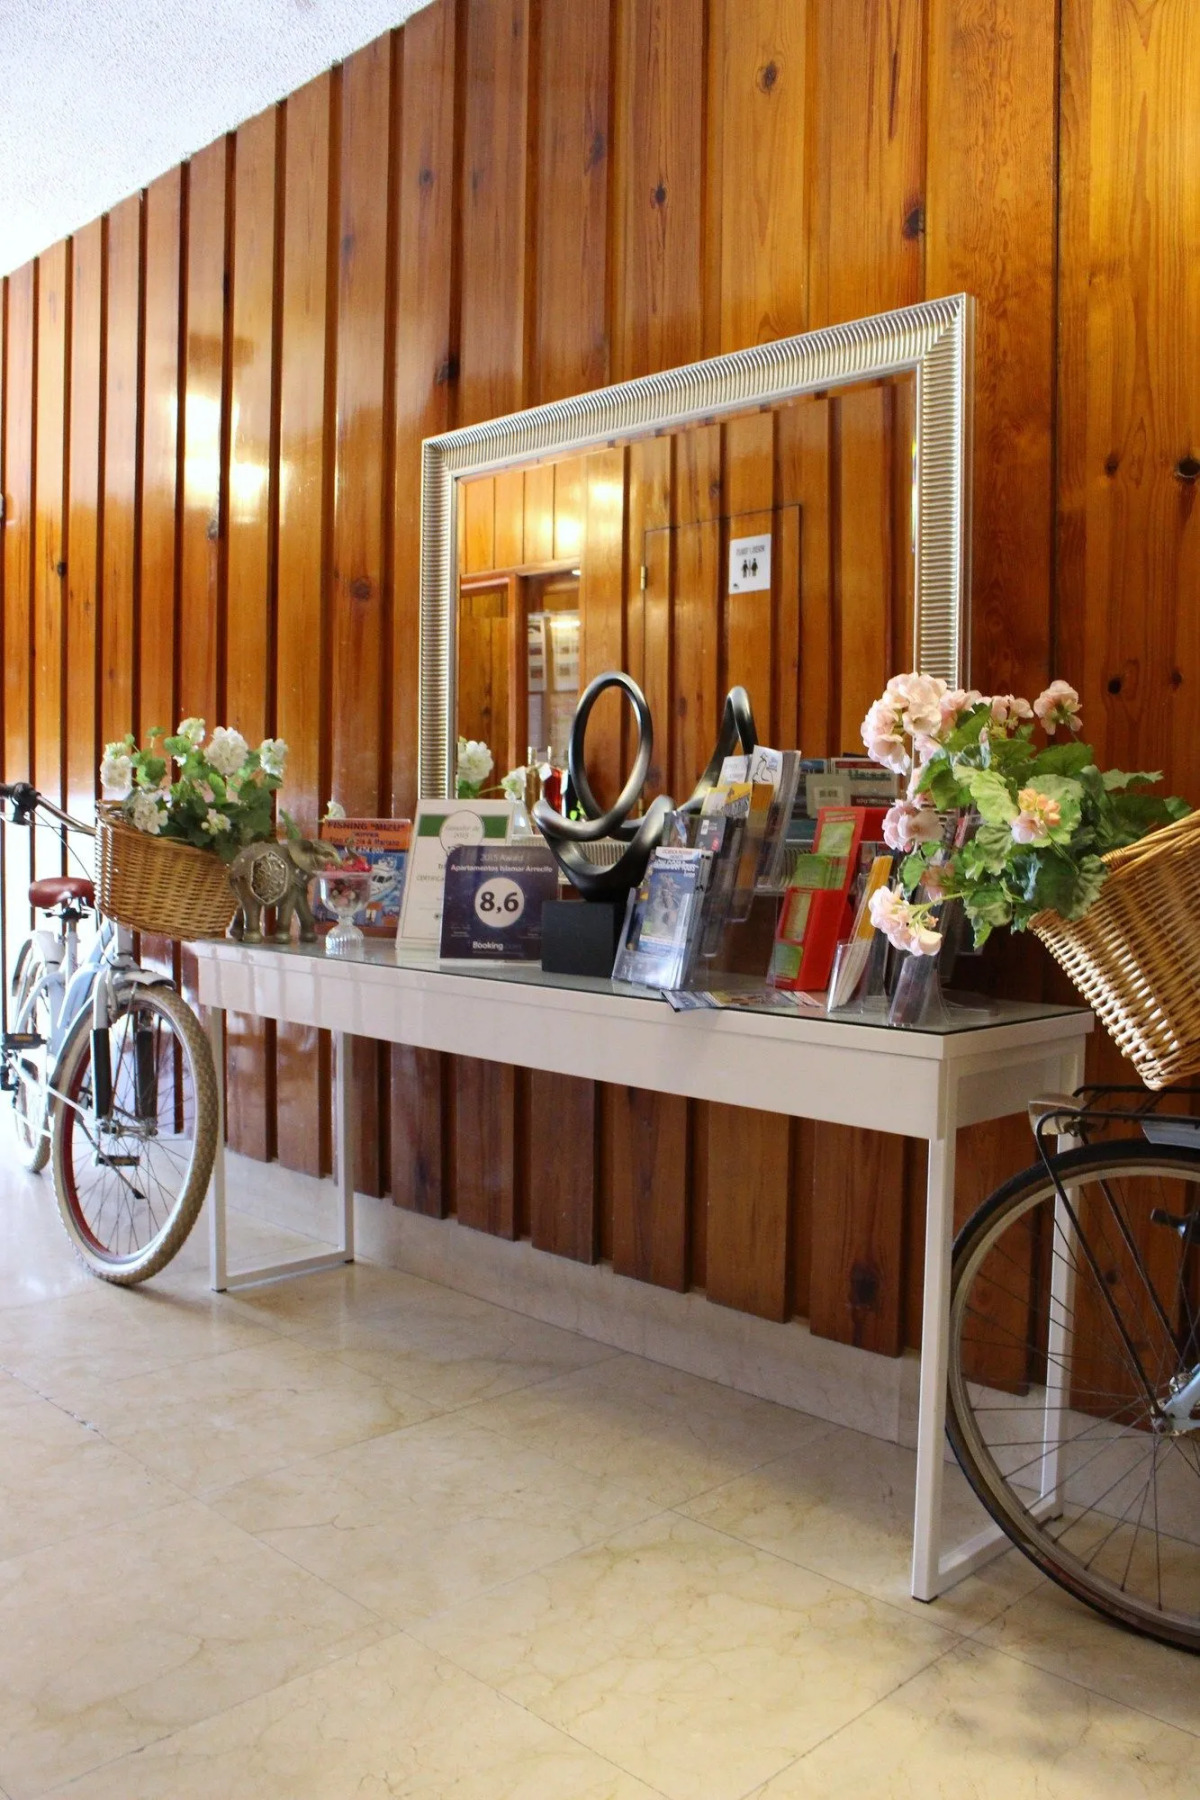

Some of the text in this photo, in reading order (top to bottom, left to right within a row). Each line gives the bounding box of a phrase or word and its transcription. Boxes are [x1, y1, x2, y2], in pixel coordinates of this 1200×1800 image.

[327, 821, 368, 830] FISHING
[500, 854, 524, 862] Award
[450, 864, 499, 873] Apartamentos
[416, 874, 445, 882] CERTIFICA
[479, 891, 520, 914] 8,6
